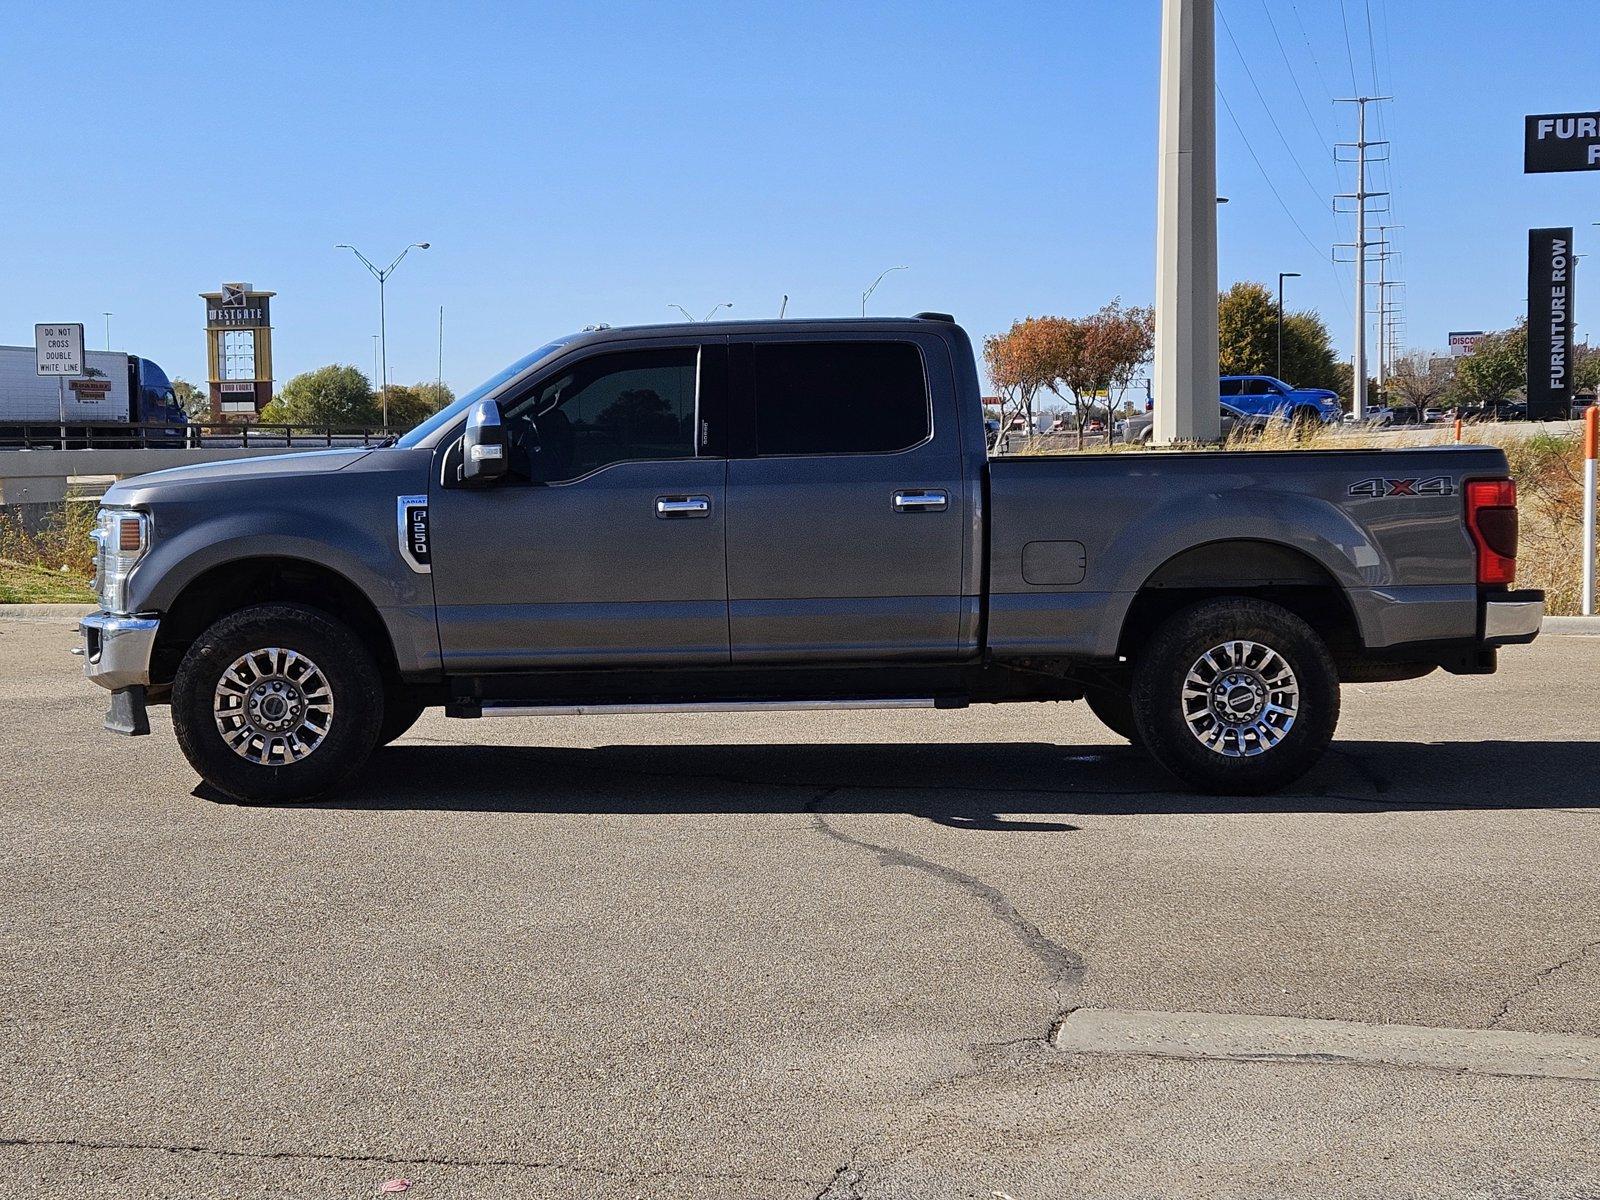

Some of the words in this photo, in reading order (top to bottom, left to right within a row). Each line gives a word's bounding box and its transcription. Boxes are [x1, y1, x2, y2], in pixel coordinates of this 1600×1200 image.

[1538, 117, 1600, 140] FUR
[1551, 238, 1567, 282] ROW
[208, 308, 262, 320] WESTGATE
[44, 328, 54, 337] DO
[58, 328, 71, 337] NOT
[1550, 285, 1567, 389] FURNITURE
[48, 339, 70, 348] CROSS
[46, 351, 72, 360] DOUBLE
[40, 363, 60, 372] WHITE
[63, 363, 79, 372] LINE
